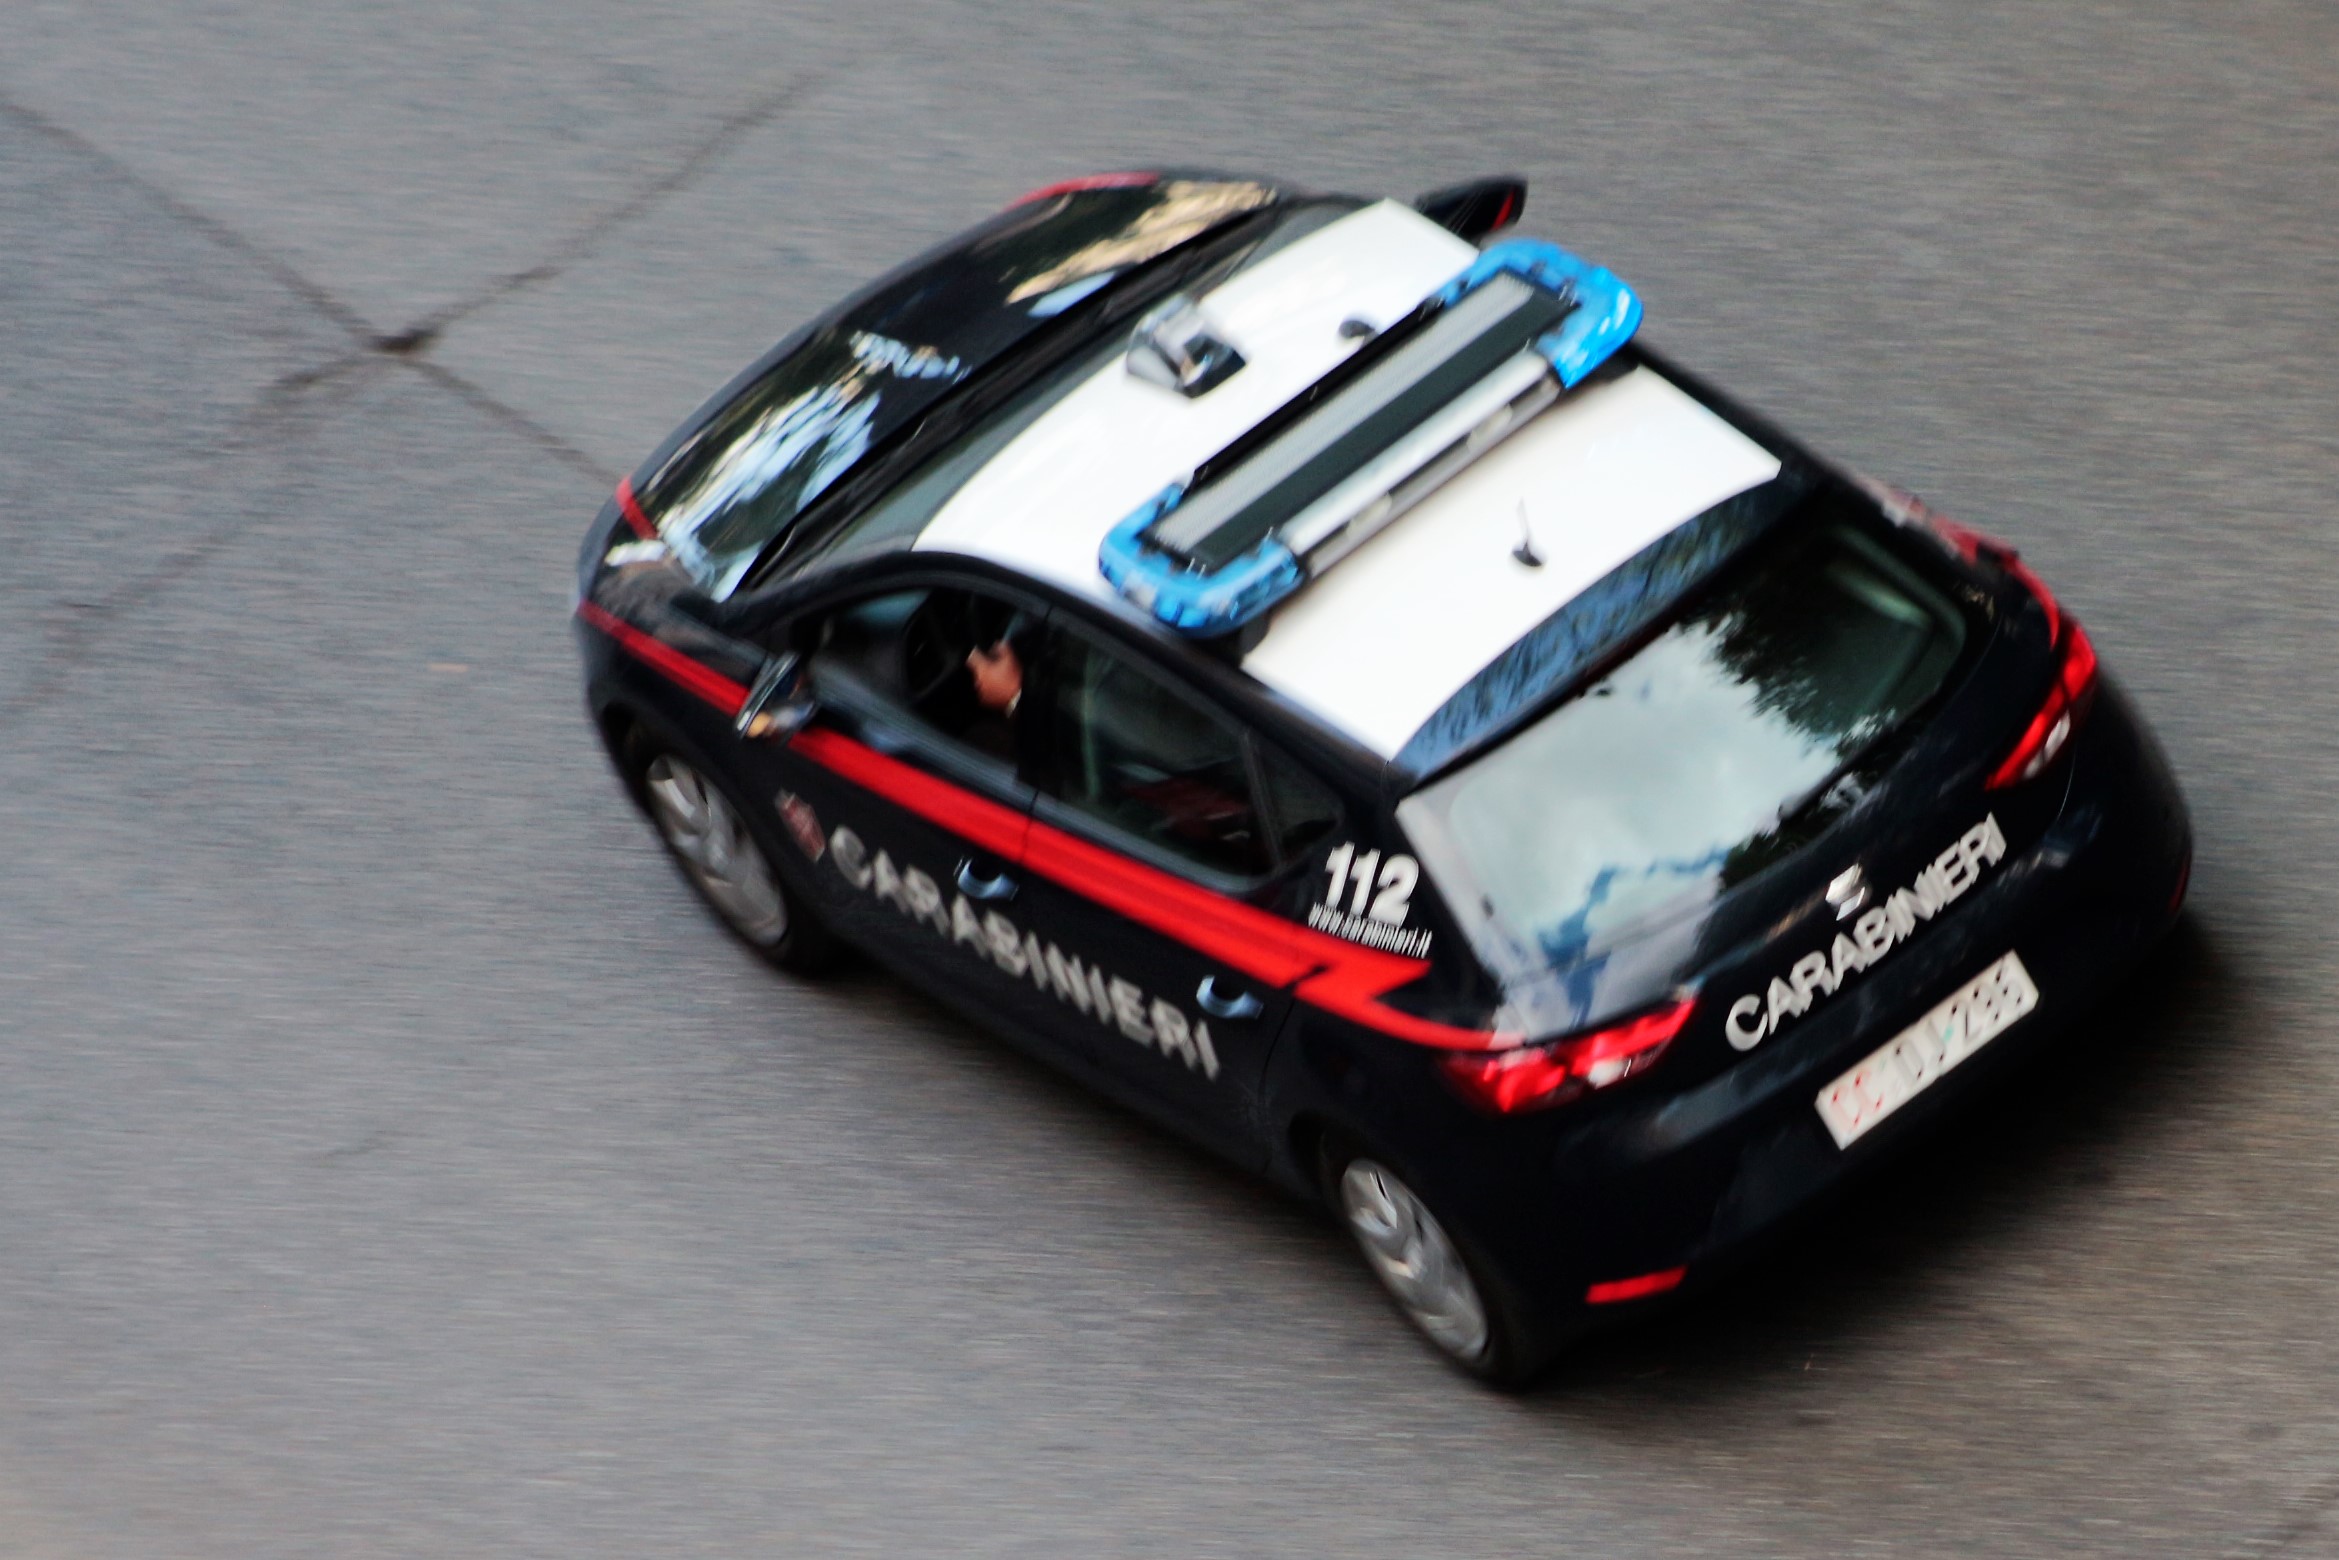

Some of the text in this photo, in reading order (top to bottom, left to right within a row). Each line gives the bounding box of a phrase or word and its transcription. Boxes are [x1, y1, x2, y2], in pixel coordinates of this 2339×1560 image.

[829, 825, 1220, 1082] CARABINIERI
[1325, 840, 1419, 926] 112
[1725, 811, 2007, 1051] CARABINIERI
